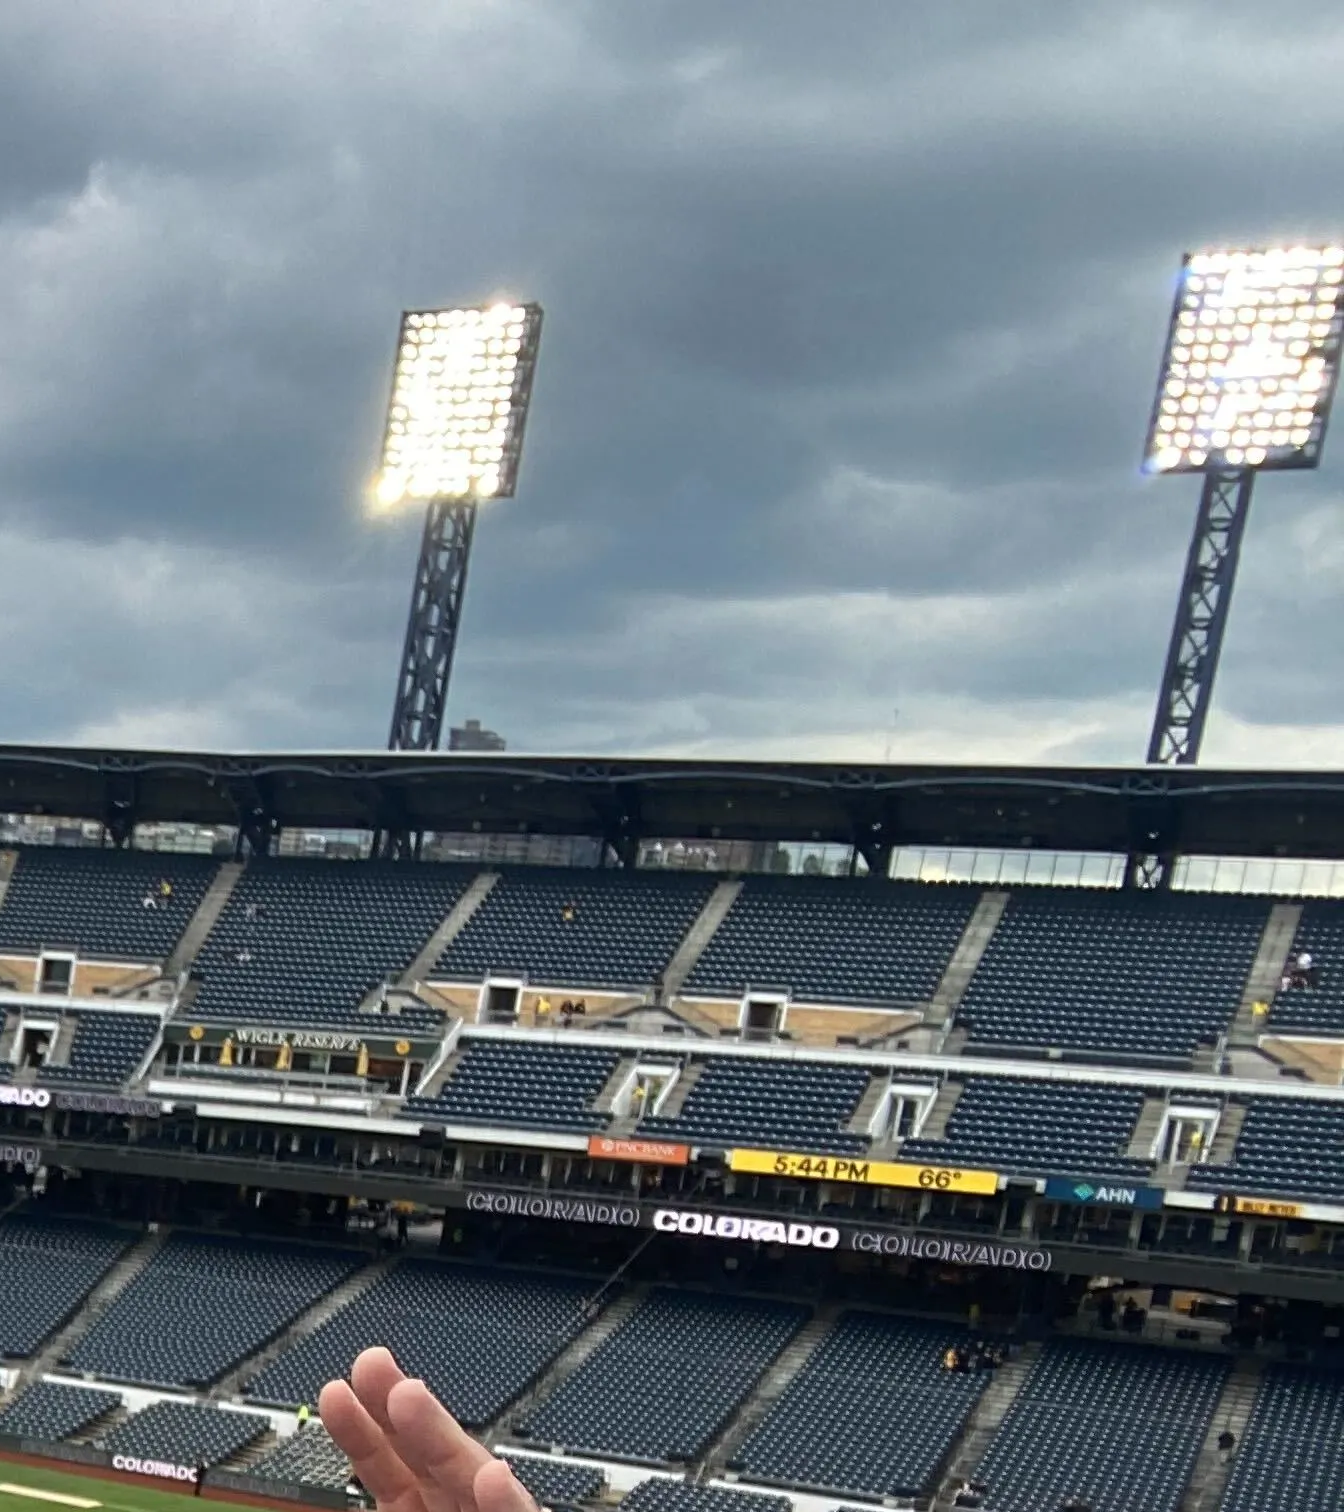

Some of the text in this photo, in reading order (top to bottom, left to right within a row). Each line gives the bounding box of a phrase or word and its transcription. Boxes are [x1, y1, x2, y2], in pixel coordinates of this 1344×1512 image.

[773, 1154, 962, 1189] 5:44 PM 66°
[1094, 1186, 1137, 1205] AHN
[653, 1209, 840, 1250] COLORADO
